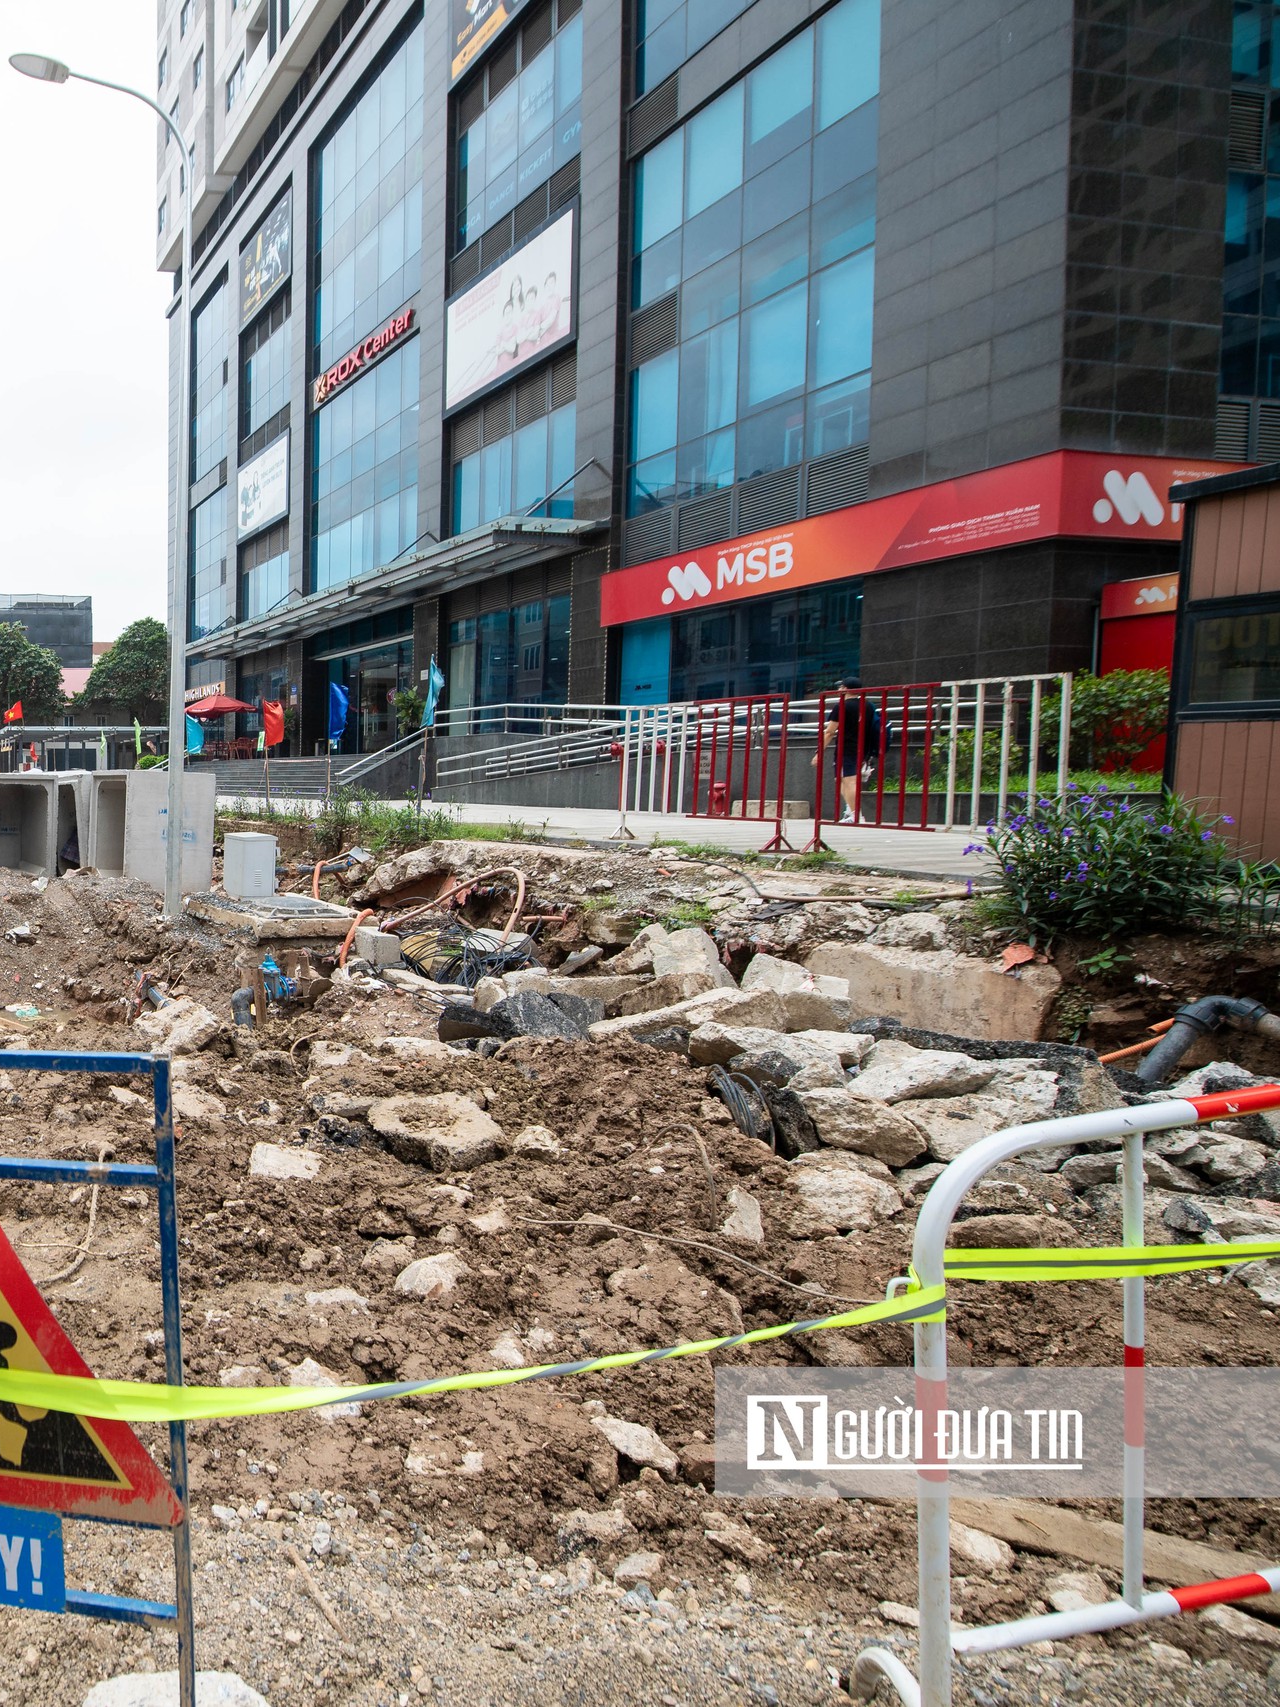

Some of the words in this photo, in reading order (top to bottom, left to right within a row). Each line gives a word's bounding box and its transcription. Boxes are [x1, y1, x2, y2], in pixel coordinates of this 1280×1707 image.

[459, 212, 481, 235] YOGA
[364, 309, 415, 358] Center
[717, 541, 794, 590] MSB
[185, 683, 221, 700] HIGHLANDS
